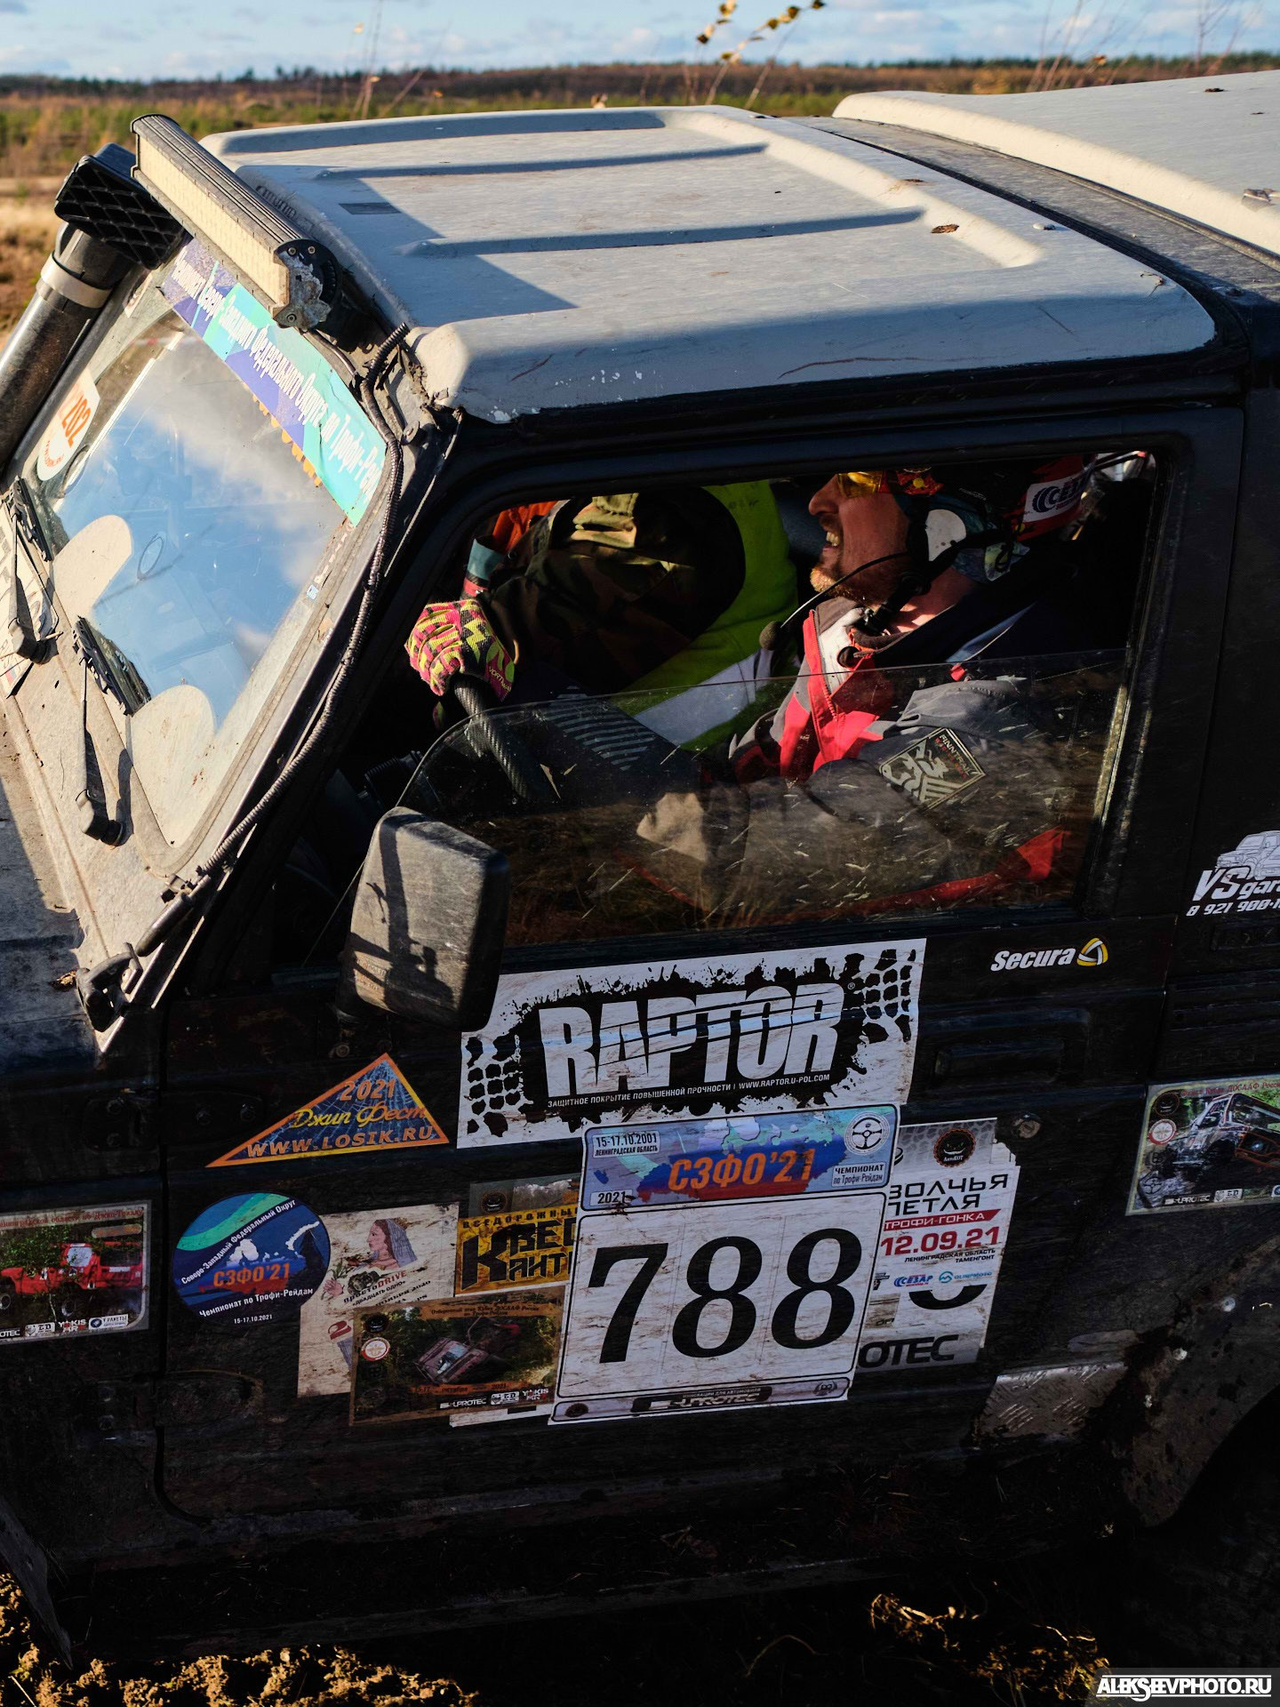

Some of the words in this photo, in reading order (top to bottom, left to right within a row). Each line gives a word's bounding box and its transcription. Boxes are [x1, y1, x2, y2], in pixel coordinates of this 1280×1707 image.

[249, 324, 305, 399] Федерального
[294, 373, 329, 426] Округа
[1204, 902, 1234, 915] 921
[991, 947, 1076, 972] Secura
[539, 982, 845, 1097] RAPTOR
[339, 1078, 397, 1102] 2021
[548, 1097, 589, 1108] ЗАЩИТНОЕ
[590, 1093, 631, 1104] ПОКРЫТИЕ
[633, 1087, 686, 1100] ПОВЫШЕННОЙ
[687, 1083, 732, 1095] ПРОЧНОСТИ
[738, 1074, 830, 1090] WWW.RAPTOR.U-POL.COM
[290, 1107, 351, 1131] Джип
[356, 1101, 428, 1126] Фест
[246, 1126, 433, 1158] WWW.LOSIK.RU
[595, 1132, 658, 1148] 15-17.10.2001
[595, 1146, 636, 1157] ЛЕНИНГРАДСКАЯ
[636, 1144, 658, 1154] ОБЛАСТЬ
[669, 1148, 816, 1191] СЗФО'21
[835, 1164, 884, 1174] ЧЕМПИОНАТ
[841, 1173, 883, 1185] Трофи-Рейдам
[597, 1191, 627, 1204] 2021
[885, 1211, 985, 1230] ТРОФИ-ГОНКА
[181, 1240, 234, 1285] Северо-Западный
[230, 1208, 276, 1244] Федеральный
[275, 1199, 296, 1214] Округ
[880, 1226, 1000, 1256] 12.09.21
[905, 1252, 963, 1263] ЛЕНИНГРАДСКАЯ
[965, 1249, 996, 1257] ОБЛАСТЬ
[955, 1255, 995, 1263] ТАМЕНГОНТ
[213, 1262, 291, 1287] СЗФО'21
[199, 1299, 243, 1318] Чемпионат
[243, 1296, 254, 1306] по
[255, 1288, 314, 1303] Трофи-Рейдам
[588, 1228, 862, 1364] 788
[234, 1314, 273, 1324] 15-17.10.2021
